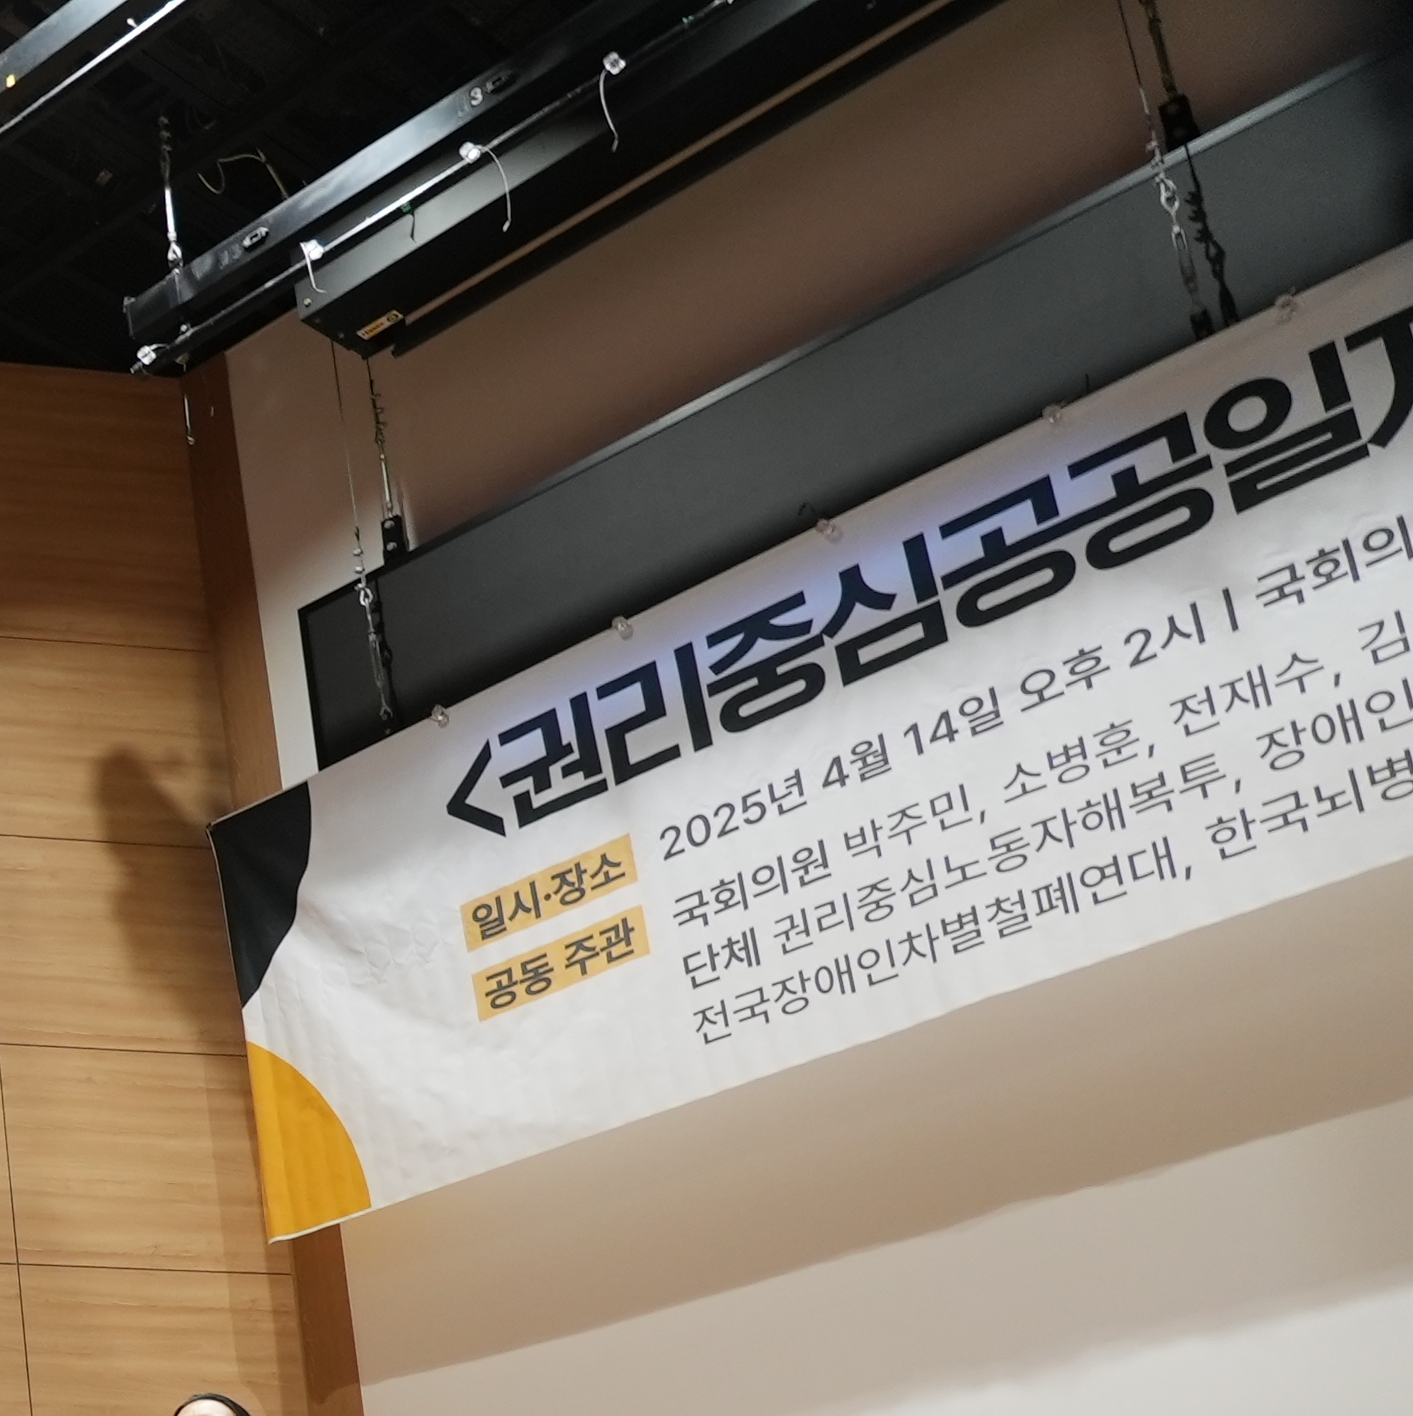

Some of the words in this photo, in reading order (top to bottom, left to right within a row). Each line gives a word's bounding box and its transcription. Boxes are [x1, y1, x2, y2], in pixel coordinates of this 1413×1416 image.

[471, 853, 627, 941] 일시·장소
[658, 768, 808, 861] 2025년
[821, 732, 893, 788] 4월
[902, 685, 1005, 757] 14일
[1019, 644, 1111, 713] 오후
[1123, 601, 1207, 670] 2시
[484, 952, 555, 1011] 공동
[563, 916, 637, 976] 주관
[672, 838, 833, 929] 국회의원
[842, 783, 988, 861] 박주민,
[1002, 718, 1156, 804] 소병훈,
[1168, 651, 1343, 738] 전재수,
[1357, 610, 1413, 667] 김
[682, 925, 762, 990] 단체
[772, 752, 1243, 957] 권리중심노동자해복투,
[691, 835, 1194, 1046] 전국장애인차별철폐연대,
